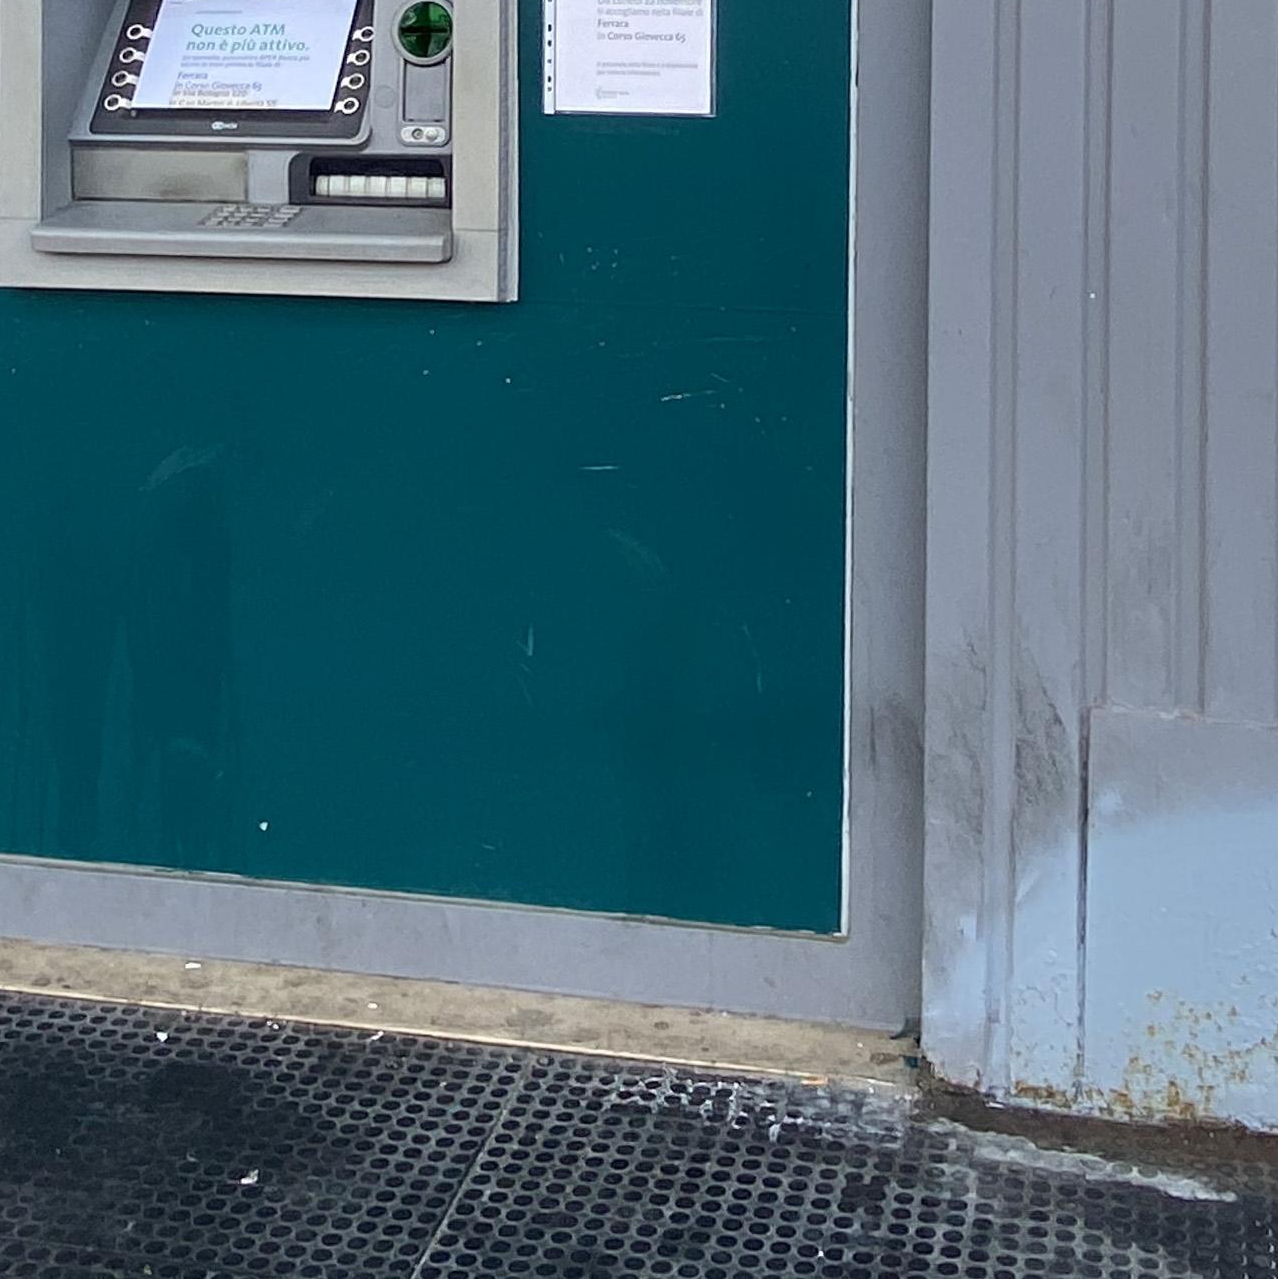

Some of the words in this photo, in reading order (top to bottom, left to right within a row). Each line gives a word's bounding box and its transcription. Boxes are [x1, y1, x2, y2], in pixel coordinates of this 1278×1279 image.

[597, 18, 630, 28] Ferrara
[191, 23, 247, 38] Questo
[249, 23, 286, 35] ATM
[607, 31, 633, 41] Corso
[634, 32, 674, 42] Giovecca
[185, 41, 216, 51] non
[219, 39, 229, 51] è
[230, 38, 256, 54] più
[258, 39, 311, 52] attivo.
